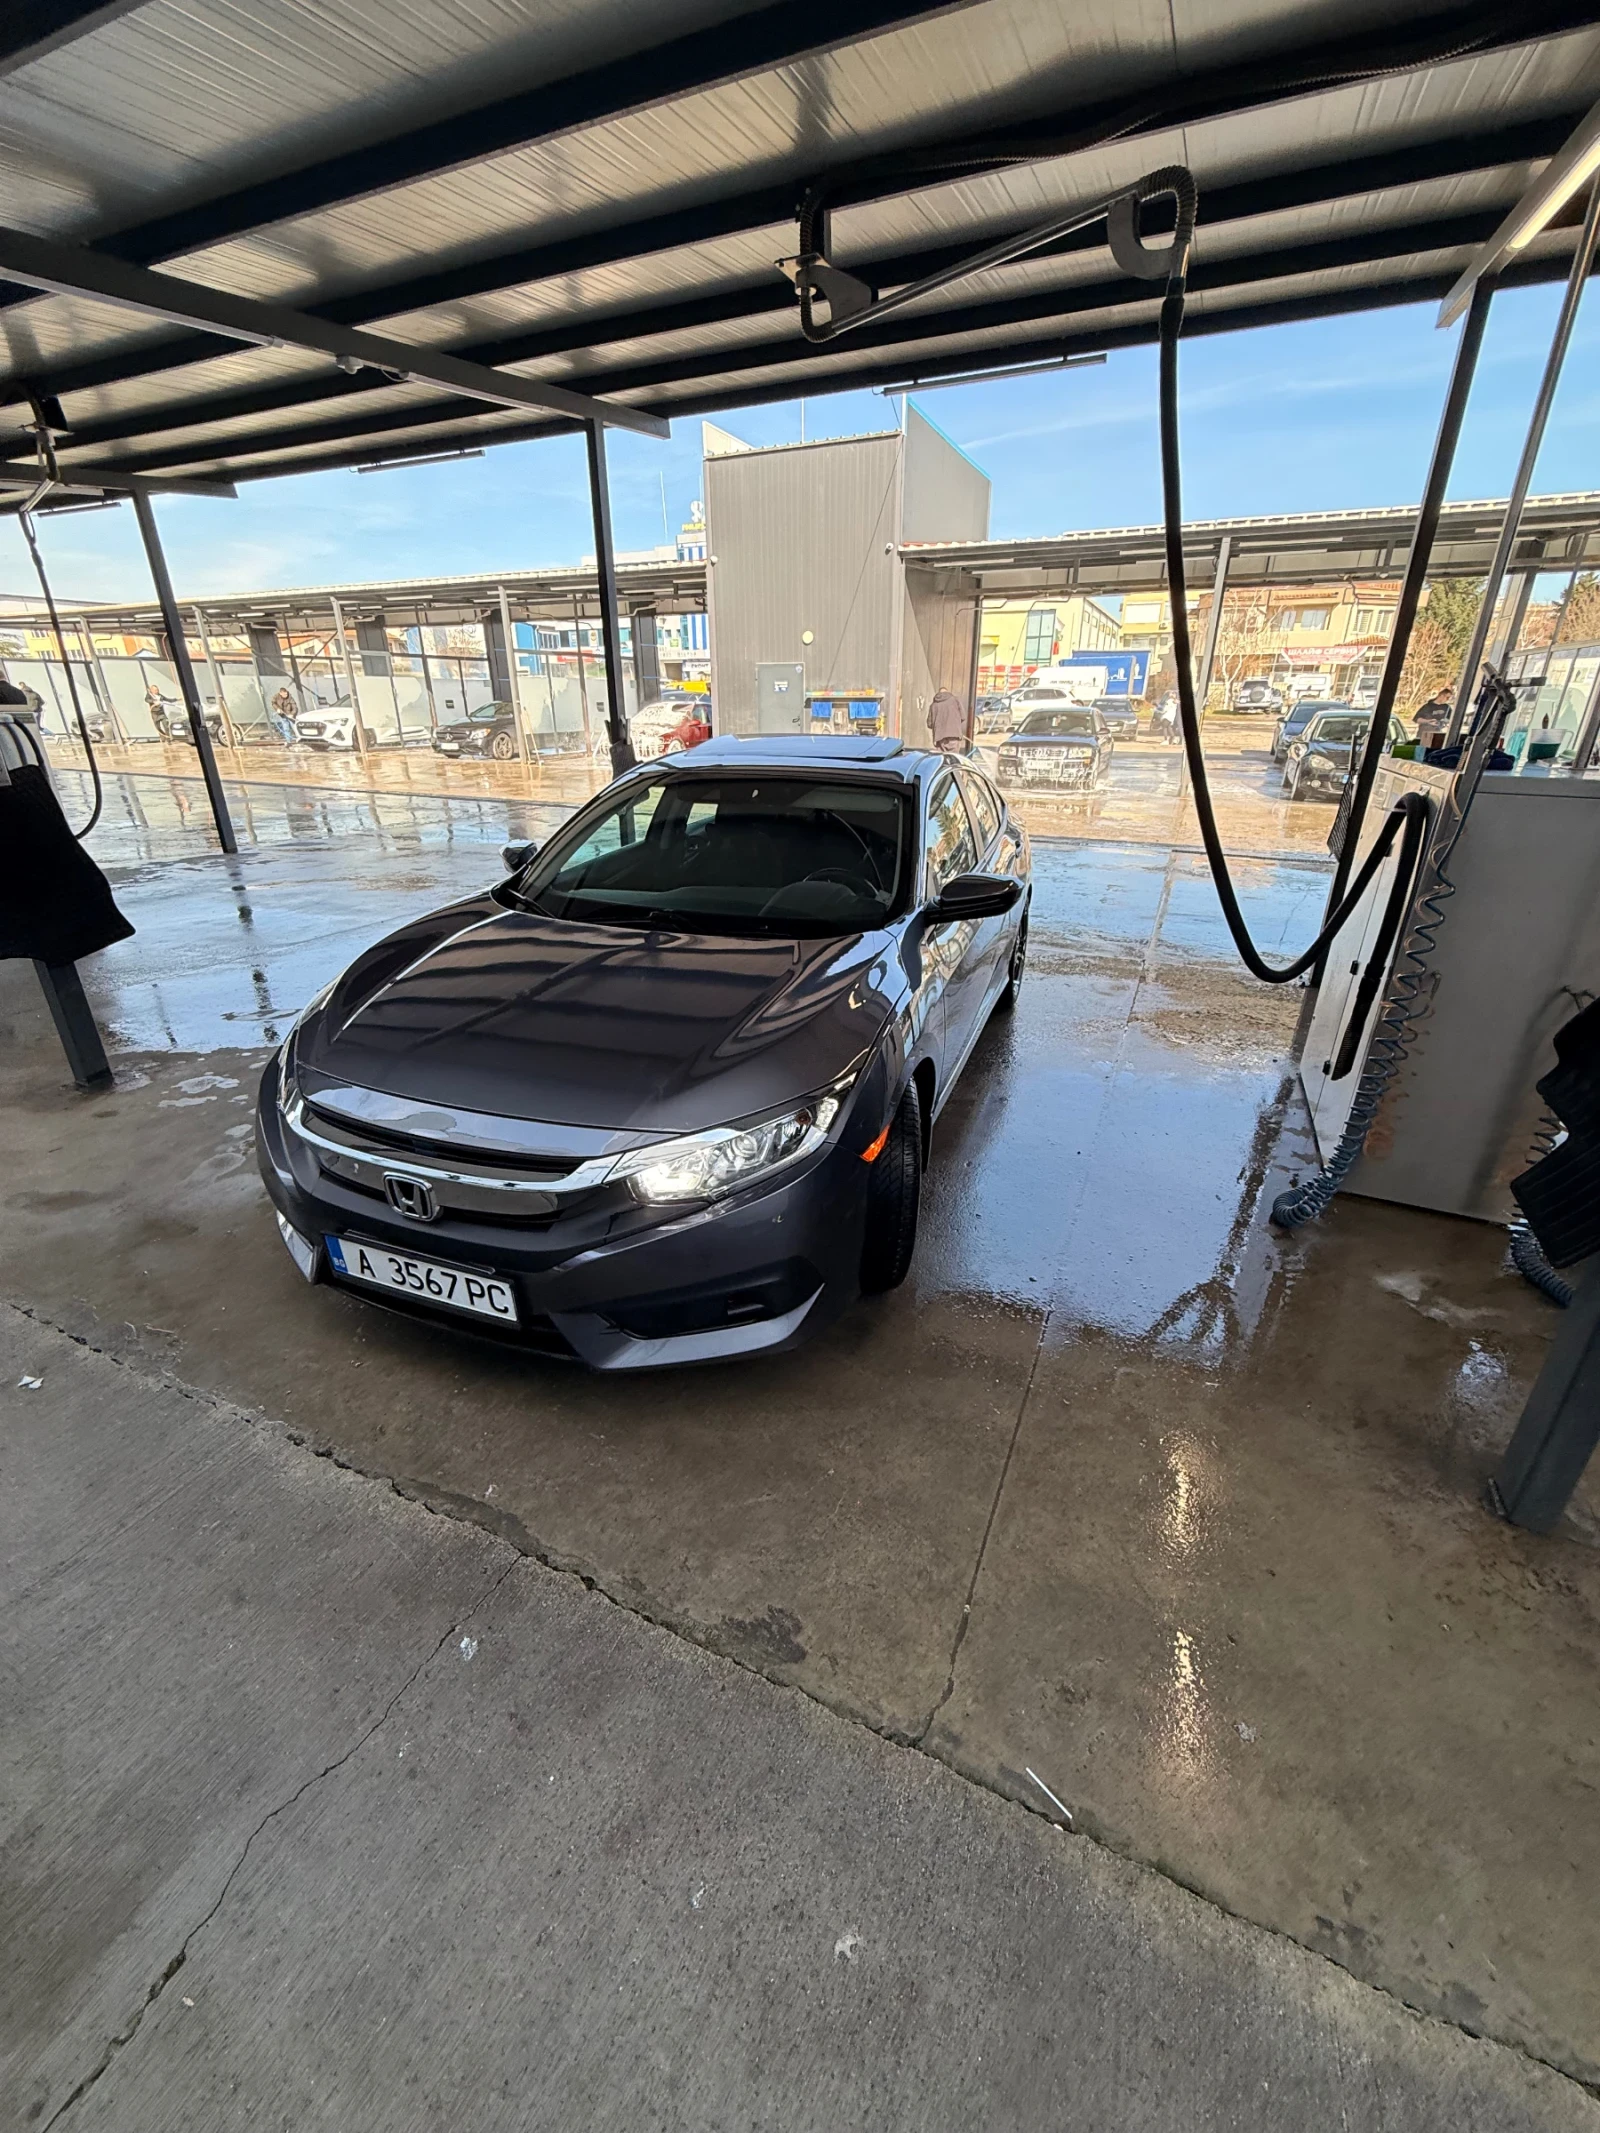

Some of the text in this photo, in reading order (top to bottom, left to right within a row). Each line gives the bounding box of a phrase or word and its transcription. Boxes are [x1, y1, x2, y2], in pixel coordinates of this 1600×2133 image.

[332, 1256, 346, 1268] BG
[359, 1248, 377, 1278] A
[388, 1257, 458, 1299] 3567
